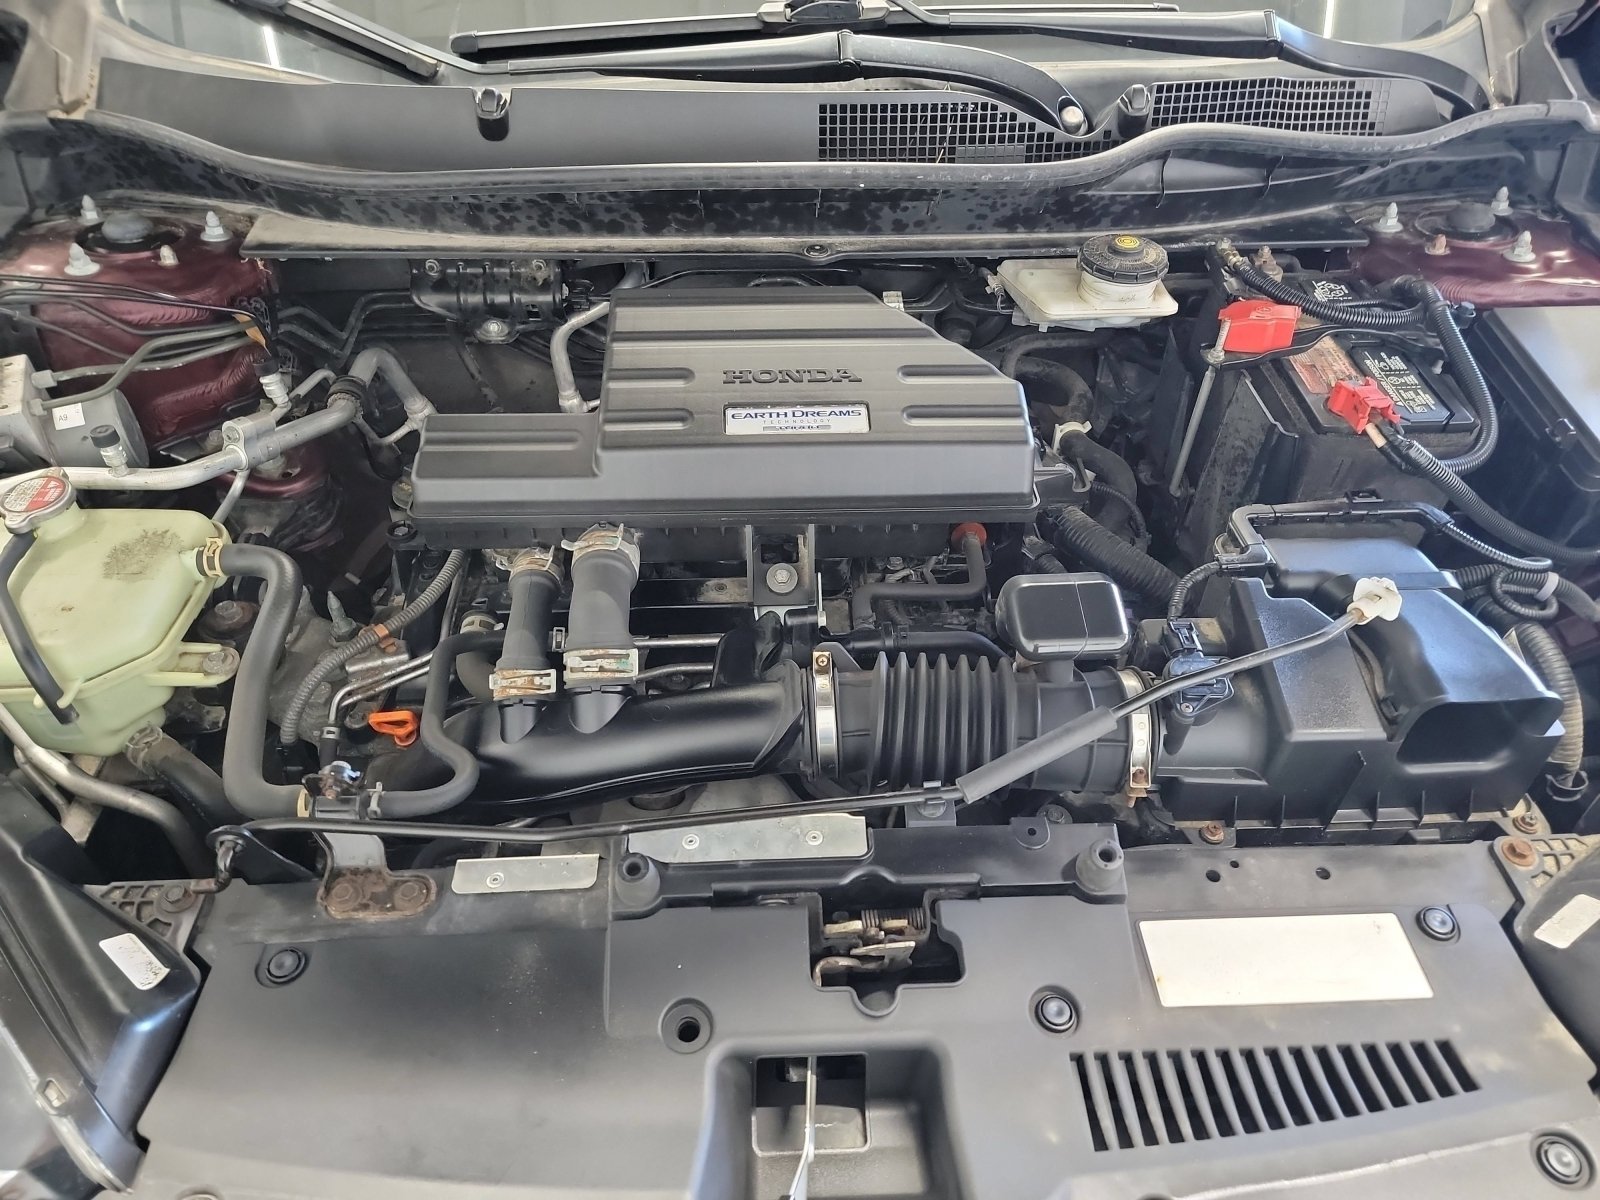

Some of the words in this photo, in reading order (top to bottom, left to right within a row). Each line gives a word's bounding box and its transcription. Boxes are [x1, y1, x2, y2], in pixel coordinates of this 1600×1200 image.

[723, 368, 863, 384] HONDA
[58, 413, 68, 422] A9
[731, 411, 788, 420] EARTH
[792, 409, 862, 418] DREAMS
